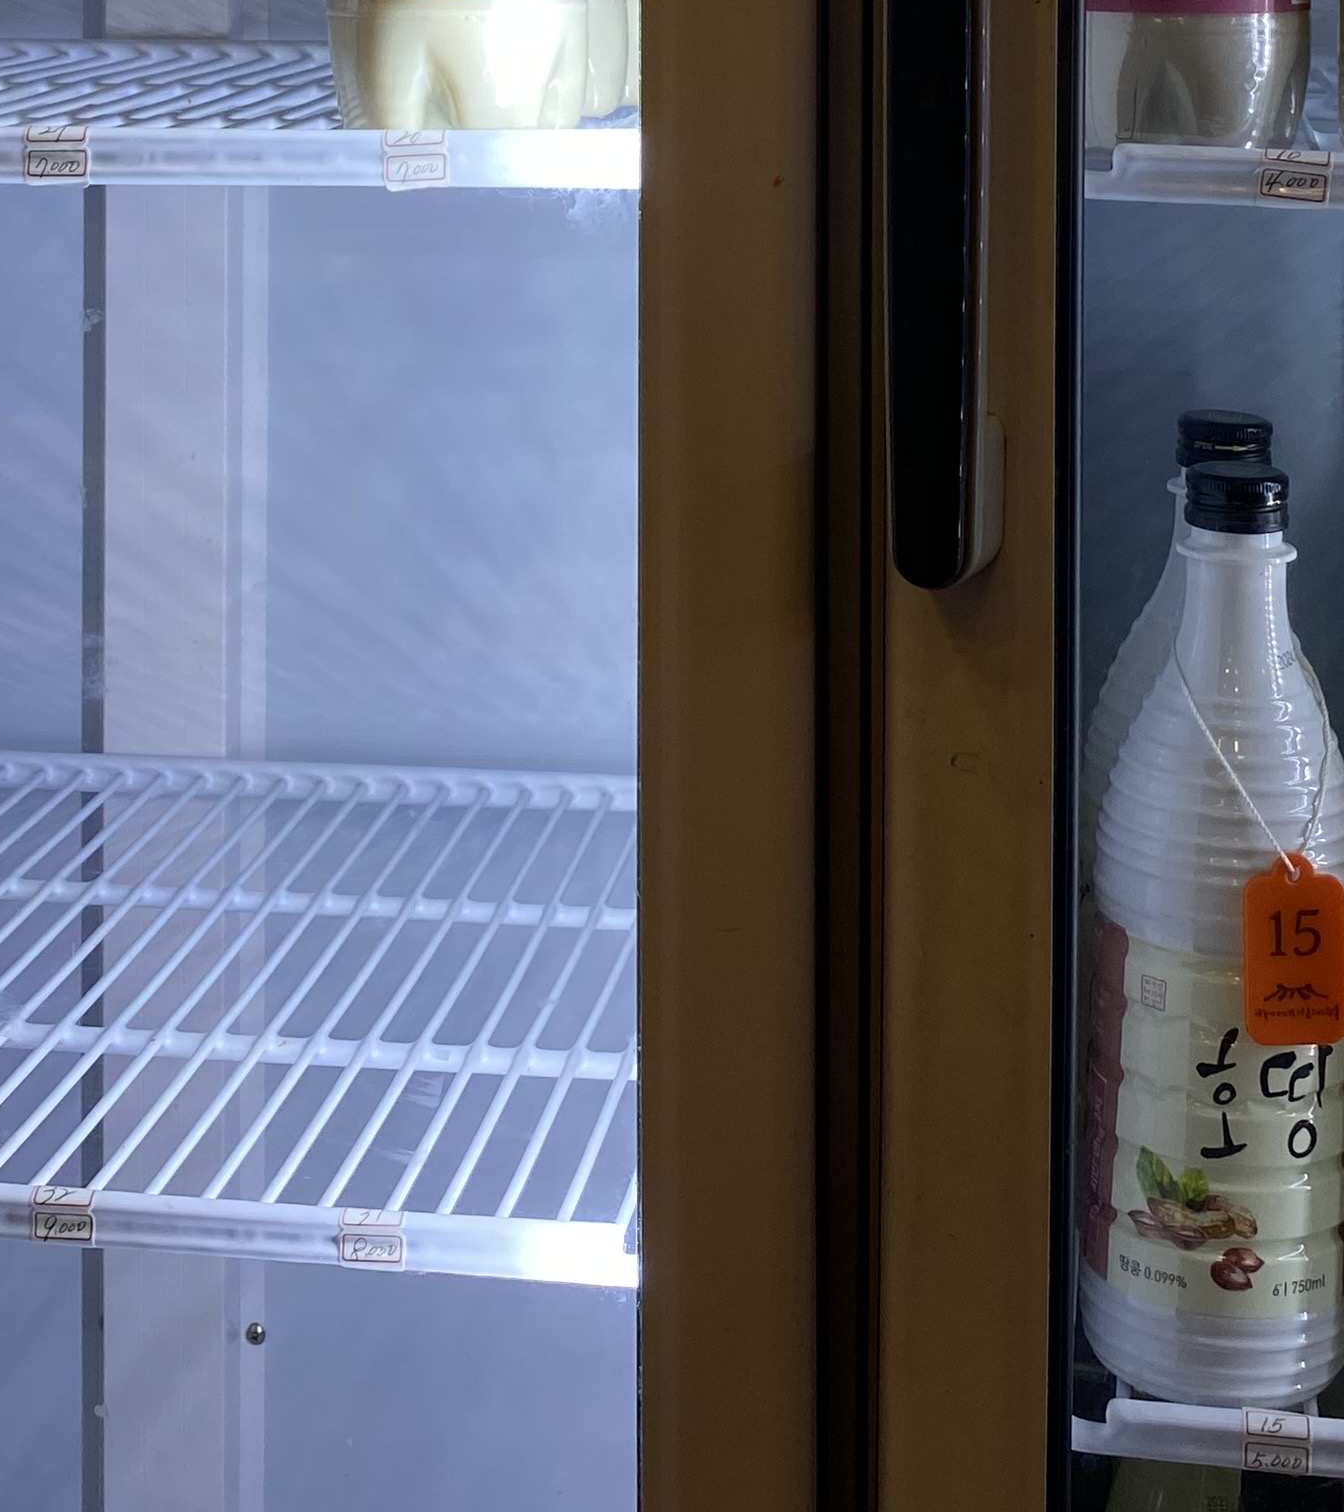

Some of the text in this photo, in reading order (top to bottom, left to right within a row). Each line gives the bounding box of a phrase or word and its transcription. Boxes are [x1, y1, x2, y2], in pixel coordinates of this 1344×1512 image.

[1268, 908, 1323, 957] 15
[1118, 1254, 1188, 1289] 땅콩 0.099%
[1292, 1273, 1326, 1295] 750ml
